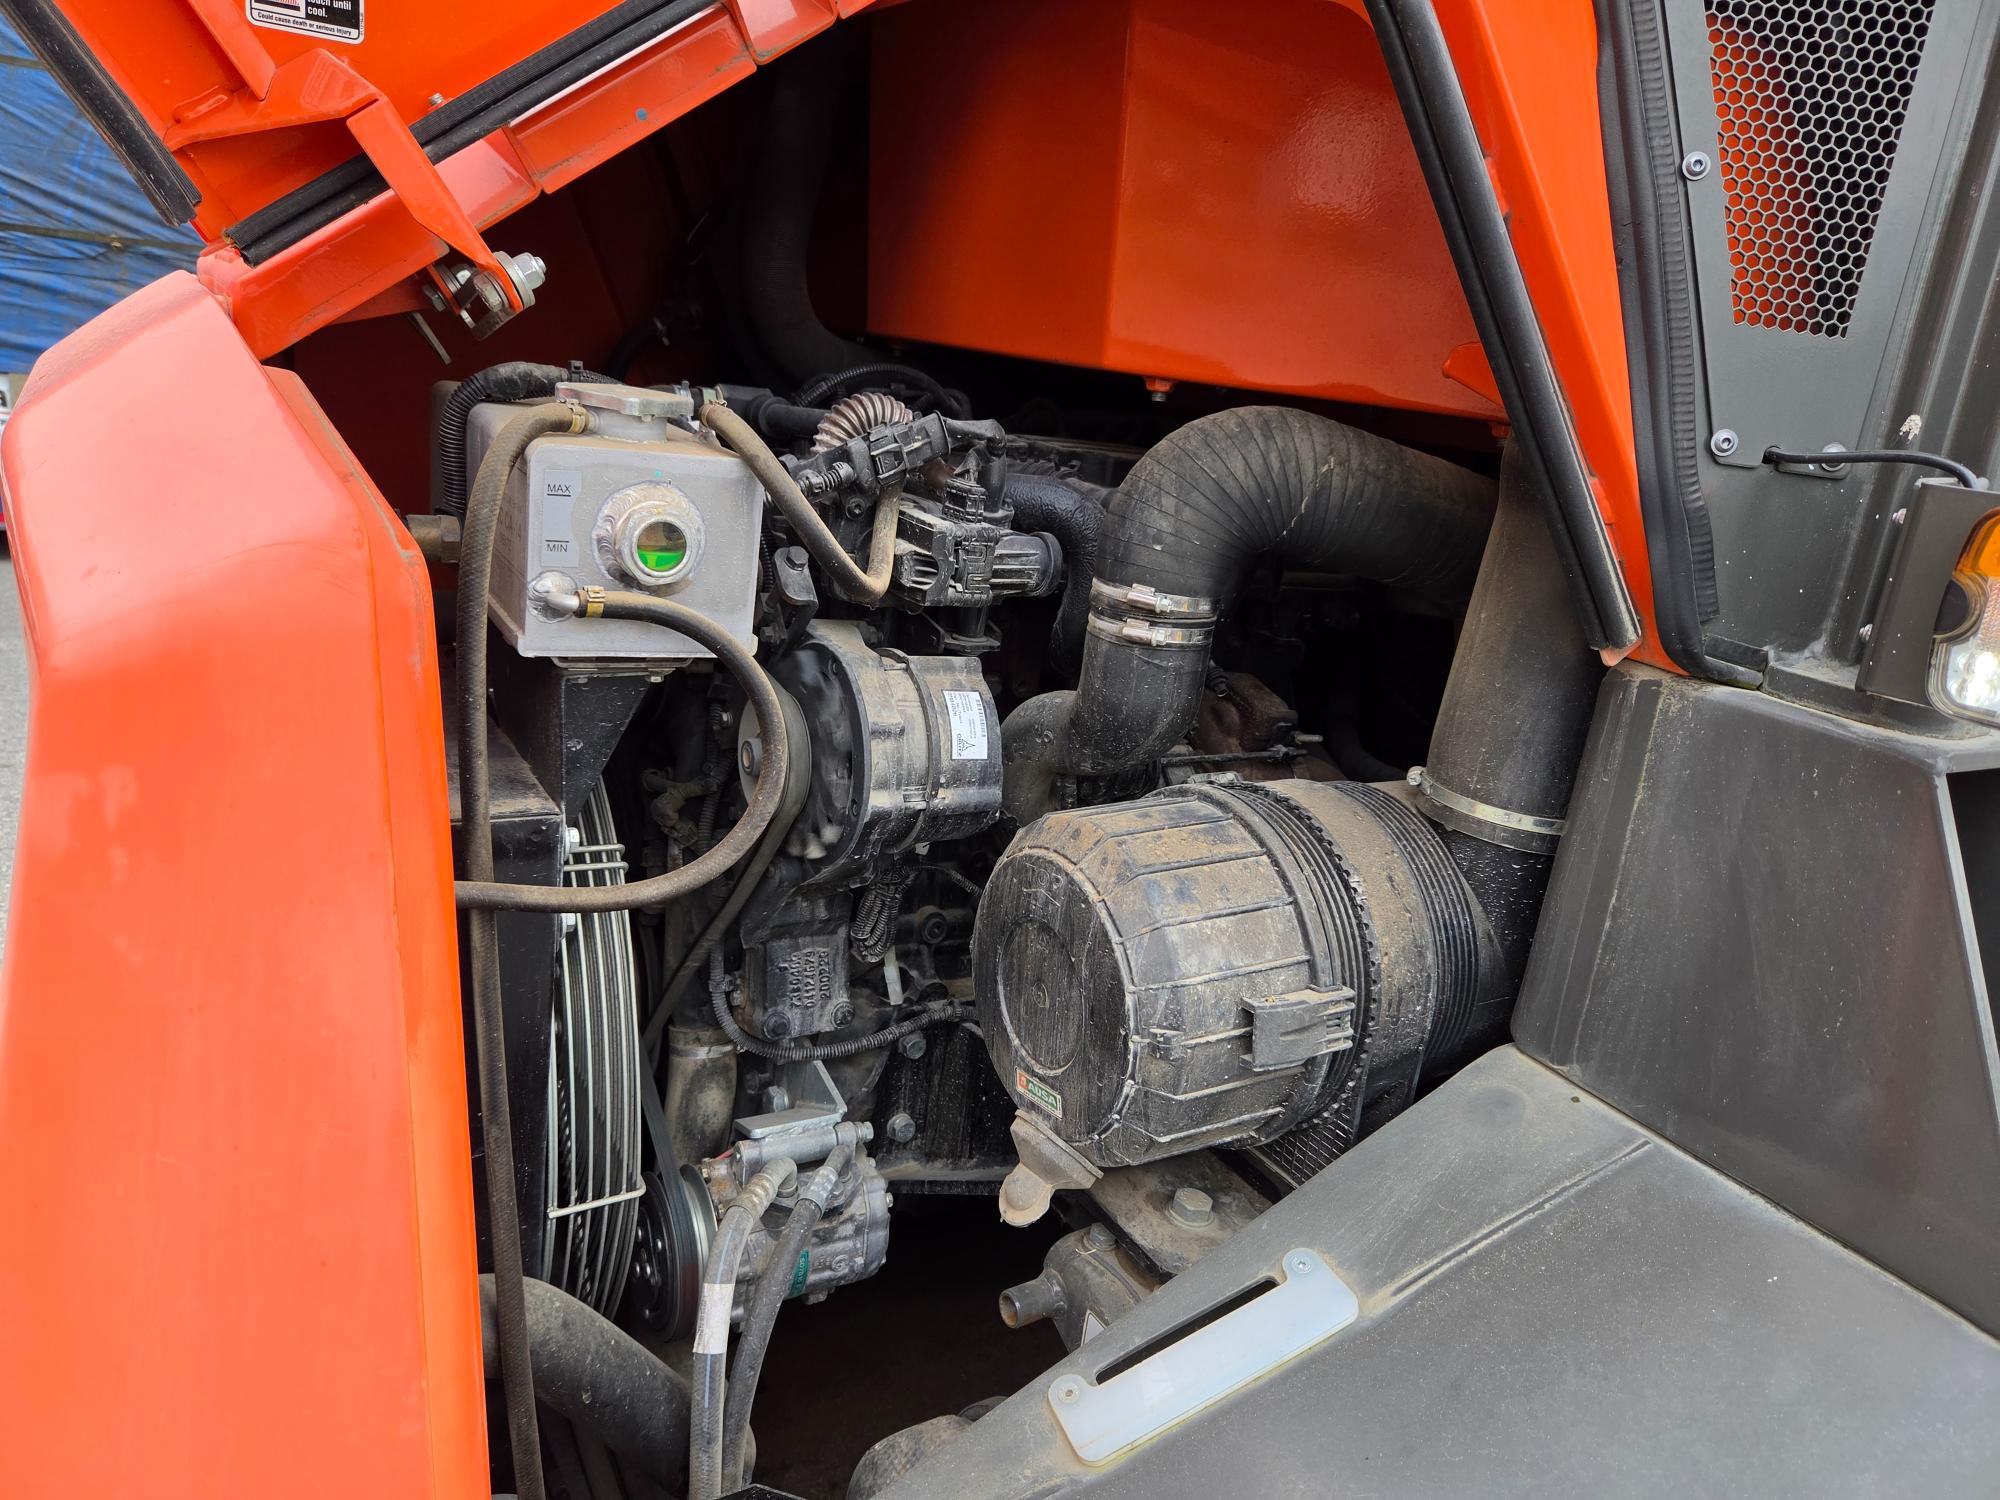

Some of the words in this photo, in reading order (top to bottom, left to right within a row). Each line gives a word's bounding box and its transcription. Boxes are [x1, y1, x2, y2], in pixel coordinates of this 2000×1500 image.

[333, 0, 352, 10] until
[307, 6, 328, 18] cool.
[257, 12, 274, 21] Could
[292, 19, 307, 27] death
[316, 24, 335, 32] serious
[336, 28, 351, 36] injury
[547, 483, 571, 494] MAX
[546, 543, 568, 553] MIN
[1028, 1081, 1057, 1108] AUSA
